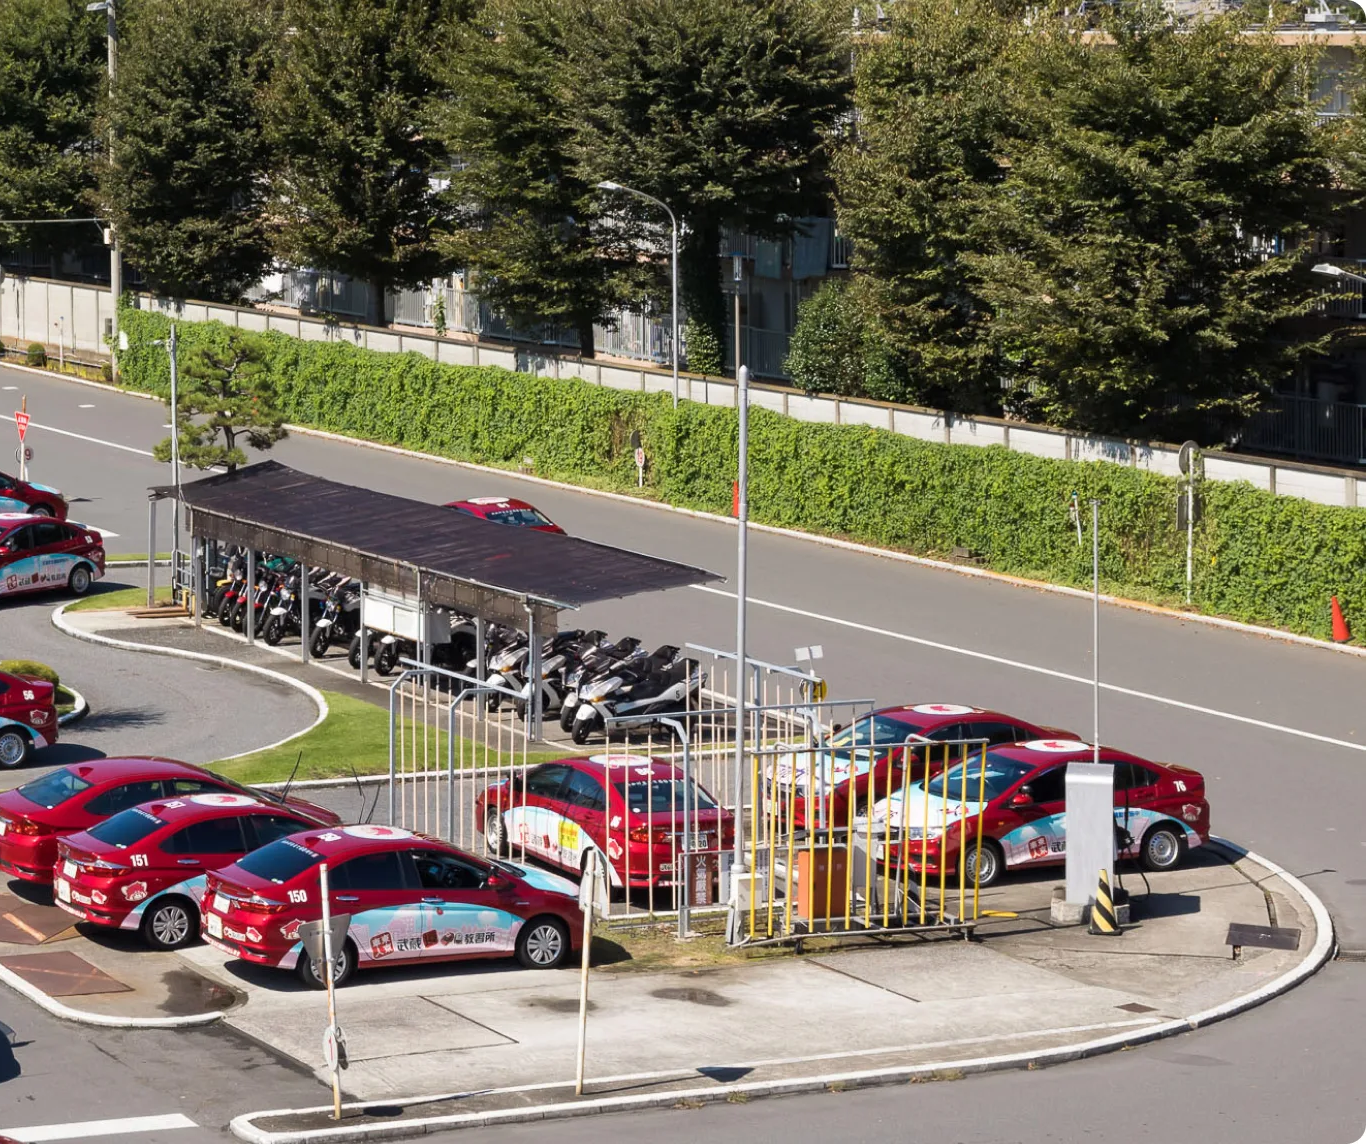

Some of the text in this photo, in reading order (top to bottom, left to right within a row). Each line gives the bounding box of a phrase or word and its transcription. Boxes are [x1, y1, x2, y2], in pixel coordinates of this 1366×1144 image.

[22, 690, 35, 700] 56
[675, 690, 680, 699] 5
[1173, 780, 1187, 792] 76
[129, 854, 149, 867] 151
[287, 889, 308, 903] 150
